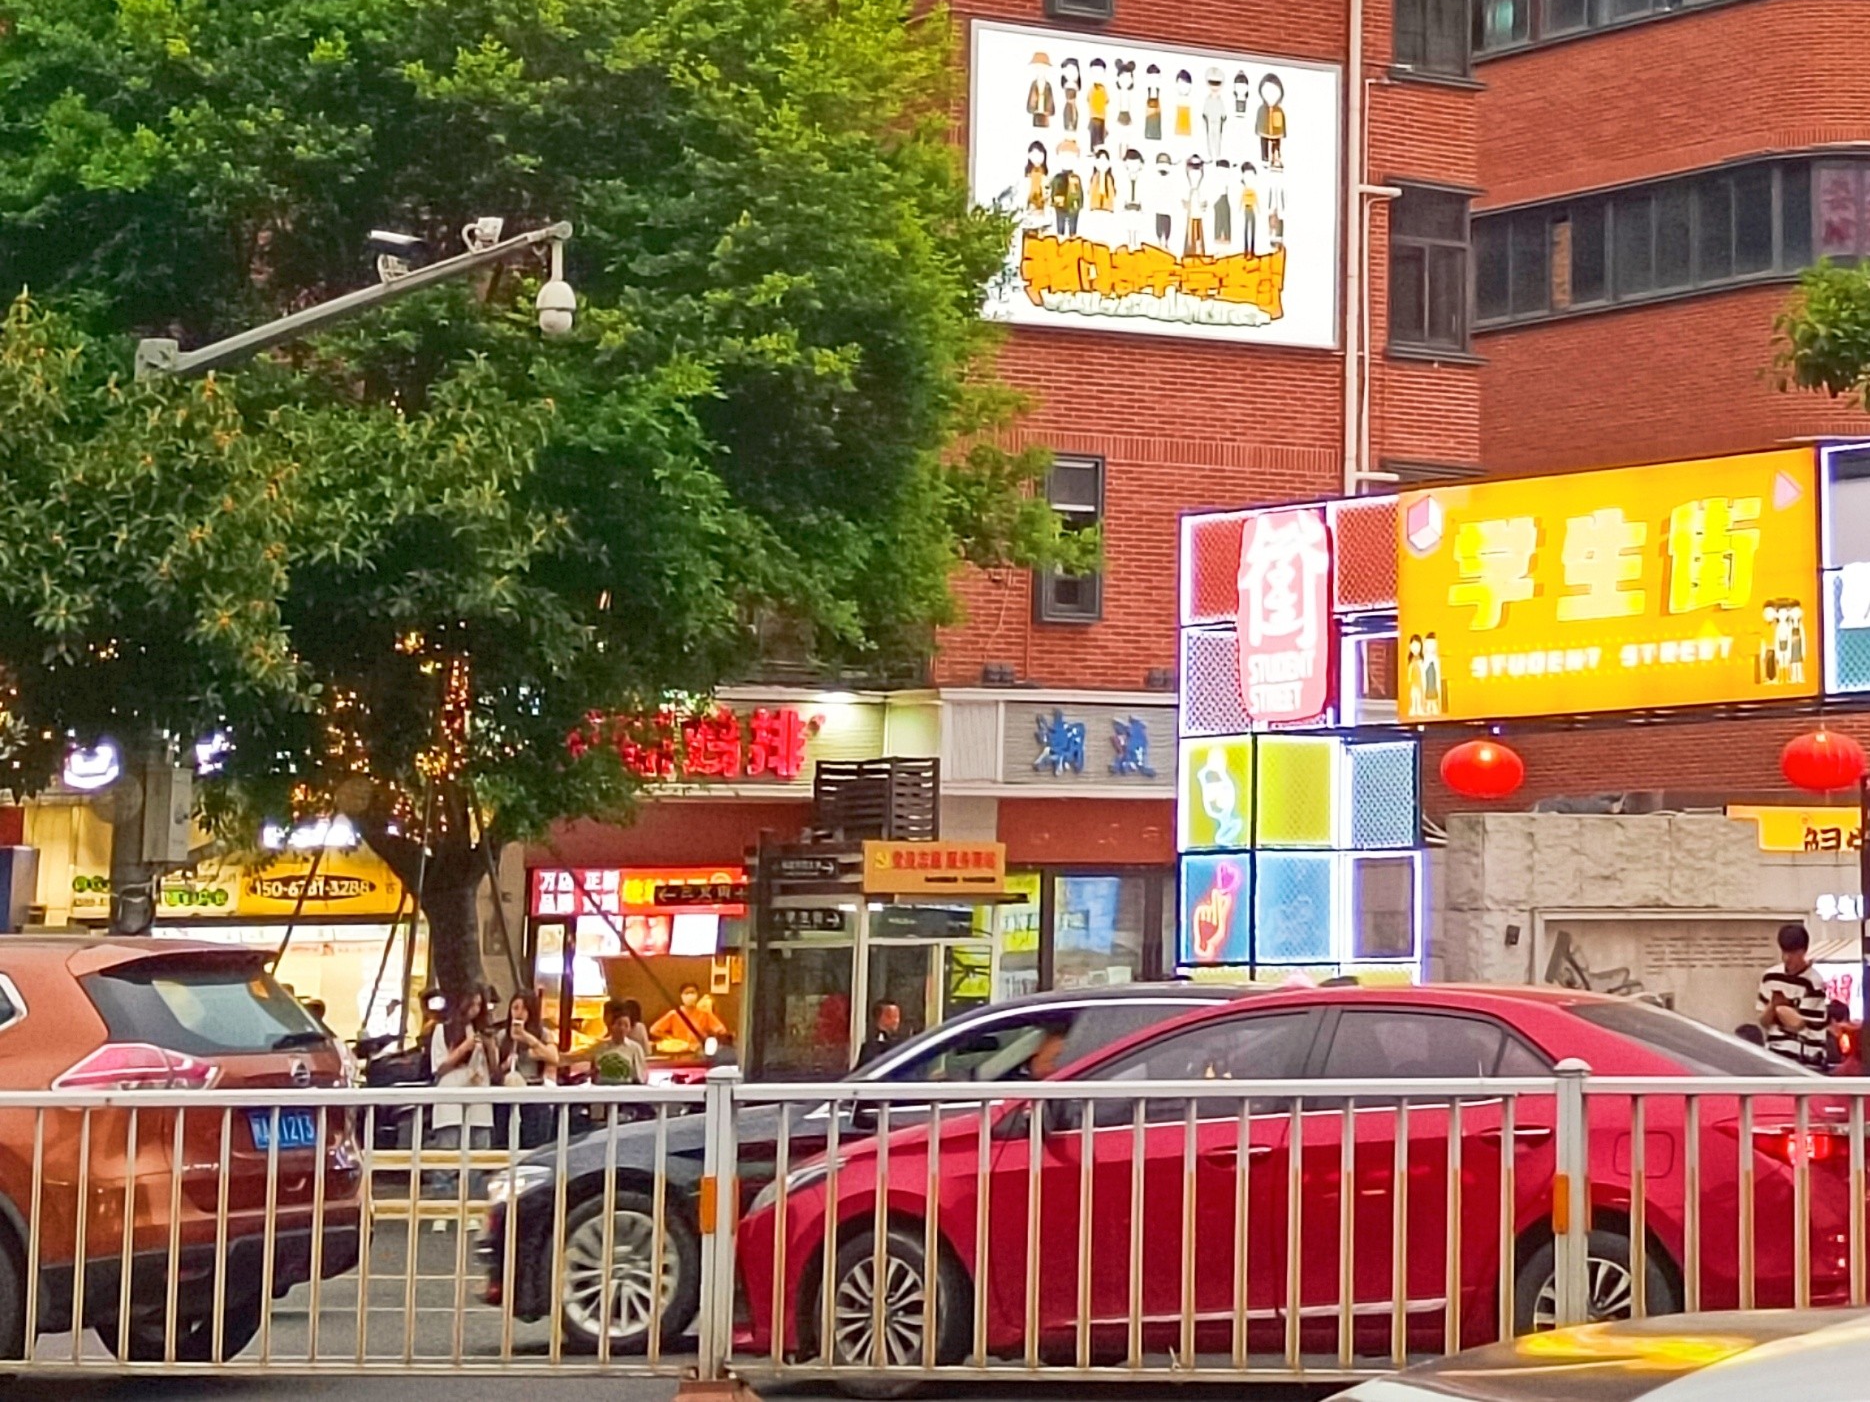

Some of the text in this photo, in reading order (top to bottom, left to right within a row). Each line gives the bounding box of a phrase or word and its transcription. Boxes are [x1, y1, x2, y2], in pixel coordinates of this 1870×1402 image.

[1447, 496, 1762, 632] 学生街
[1470, 646, 1602, 679] STUDENT
